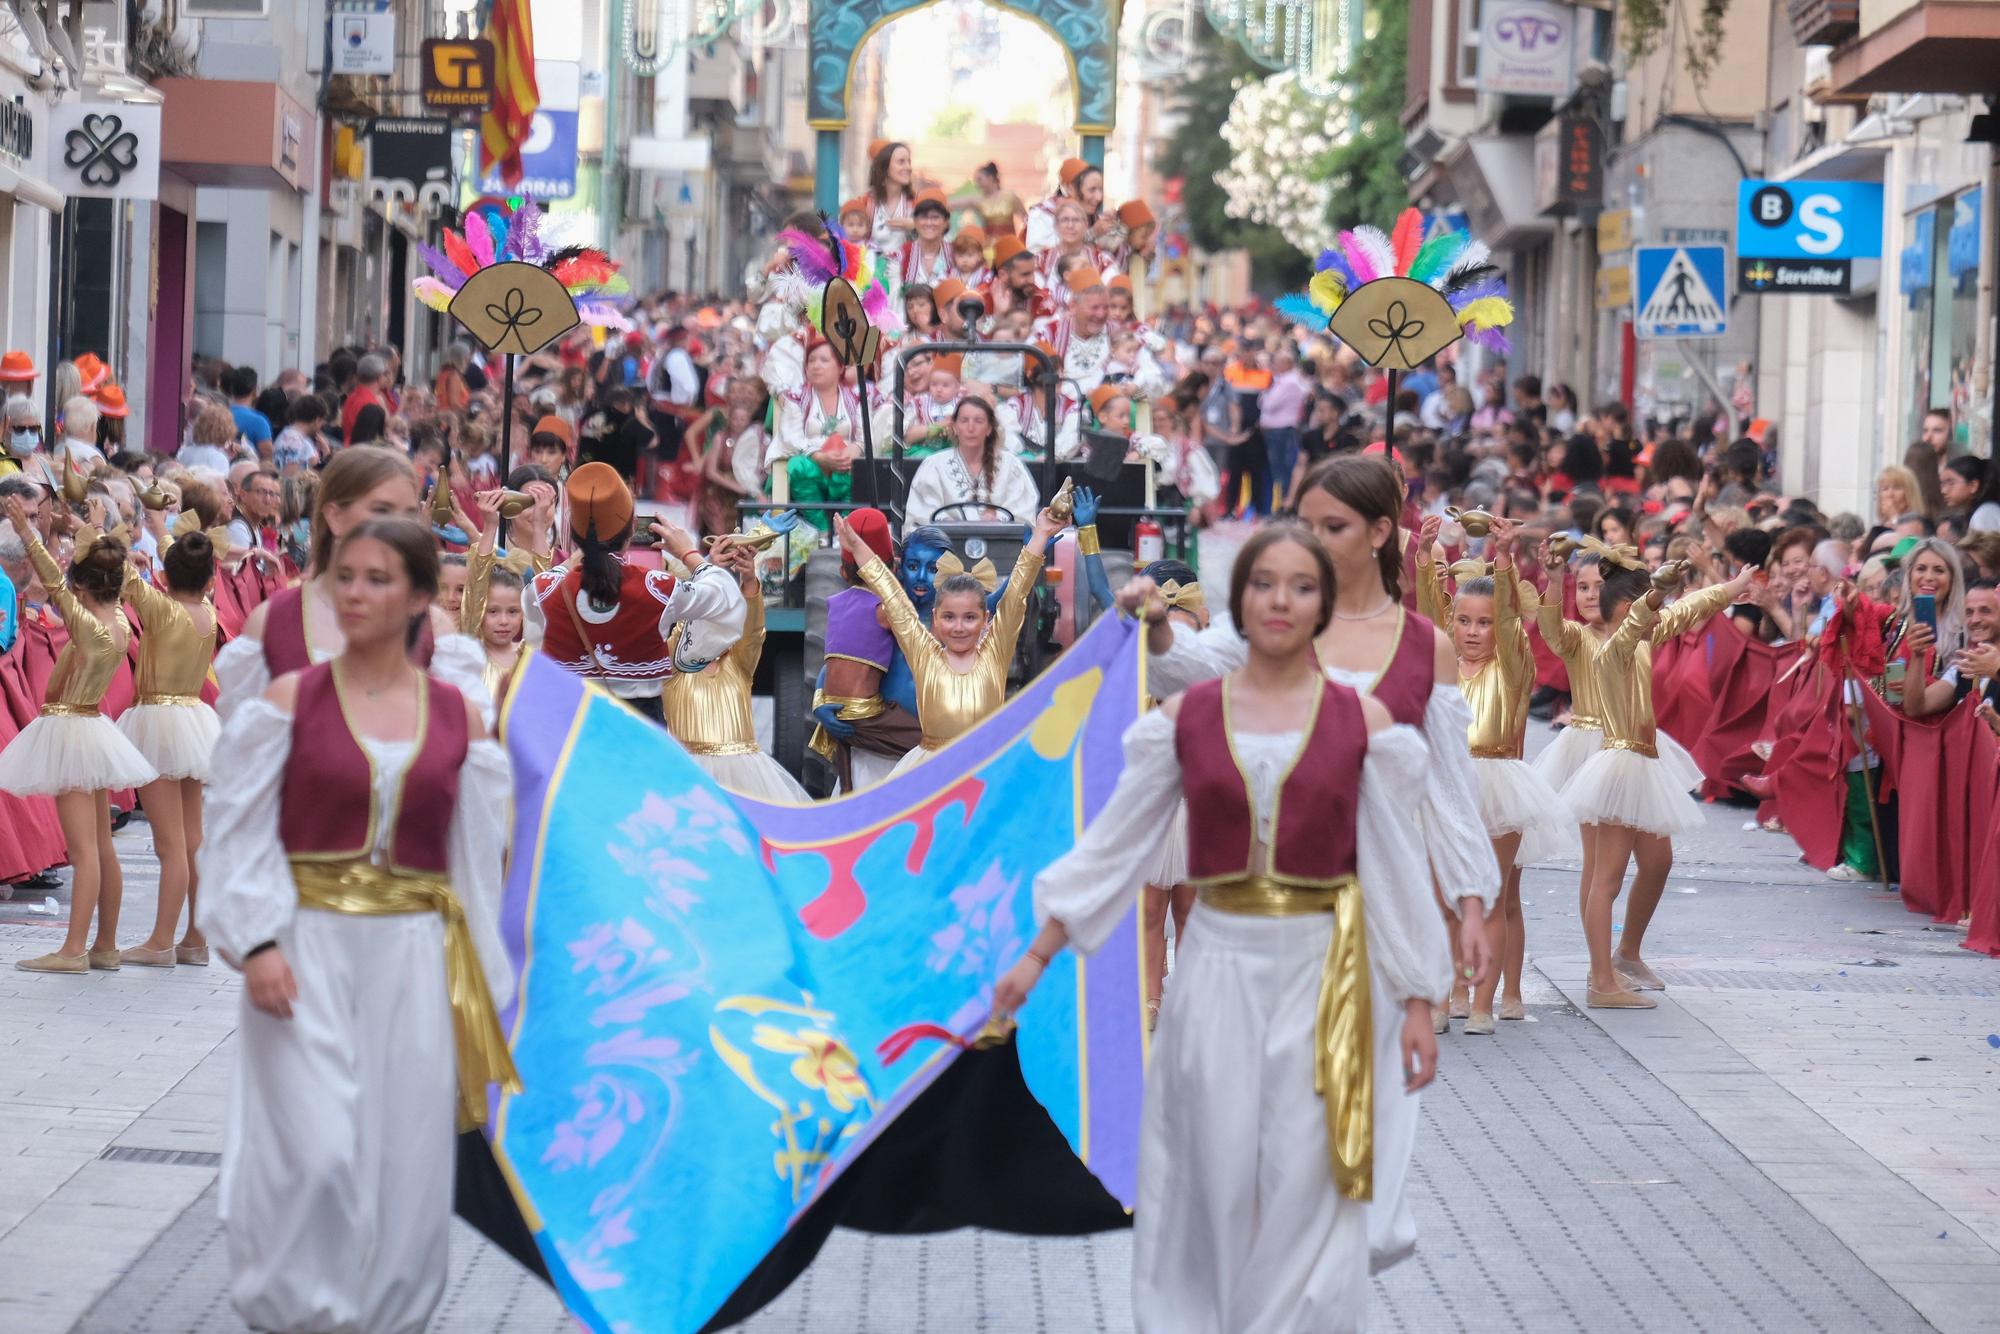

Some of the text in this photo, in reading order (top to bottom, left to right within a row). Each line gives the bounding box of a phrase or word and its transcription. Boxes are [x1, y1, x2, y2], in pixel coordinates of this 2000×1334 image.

[426, 93, 488, 105] TABACOS
[1761, 193, 1844, 254] B S
[1776, 266, 1843, 285] ServiRed
